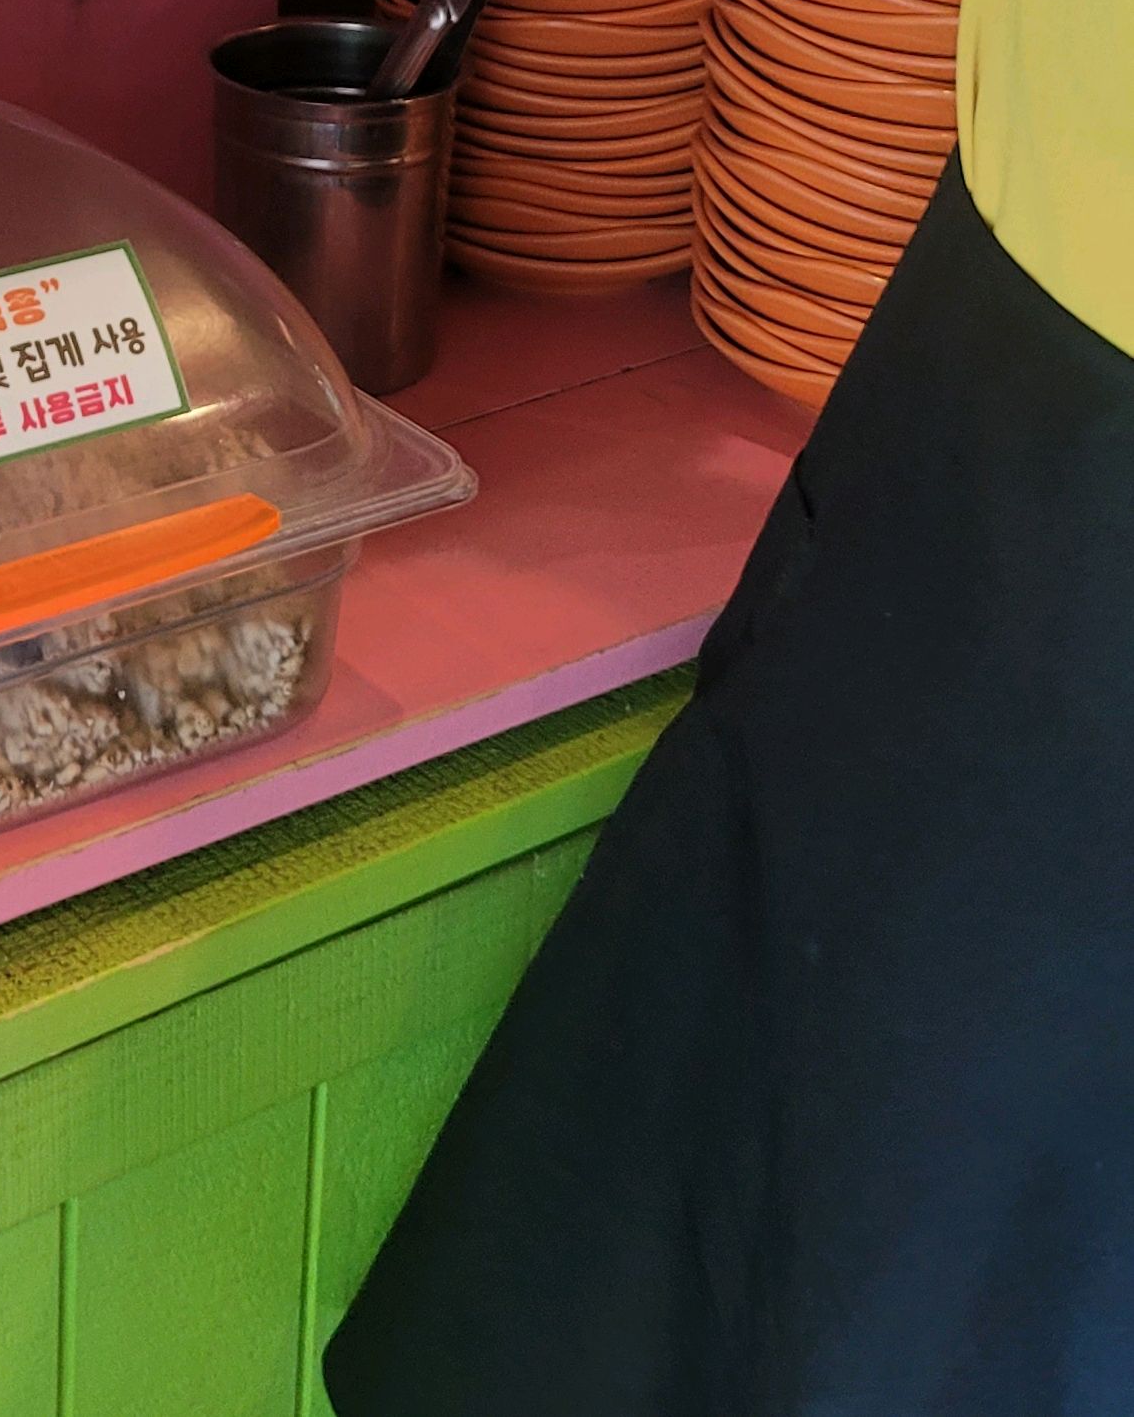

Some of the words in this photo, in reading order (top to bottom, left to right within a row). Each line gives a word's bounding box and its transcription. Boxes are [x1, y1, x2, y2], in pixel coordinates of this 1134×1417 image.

[10, 330, 86, 384] 집게
[92, 316, 147, 356] 사용
[19, 373, 136, 432] 사용금지
